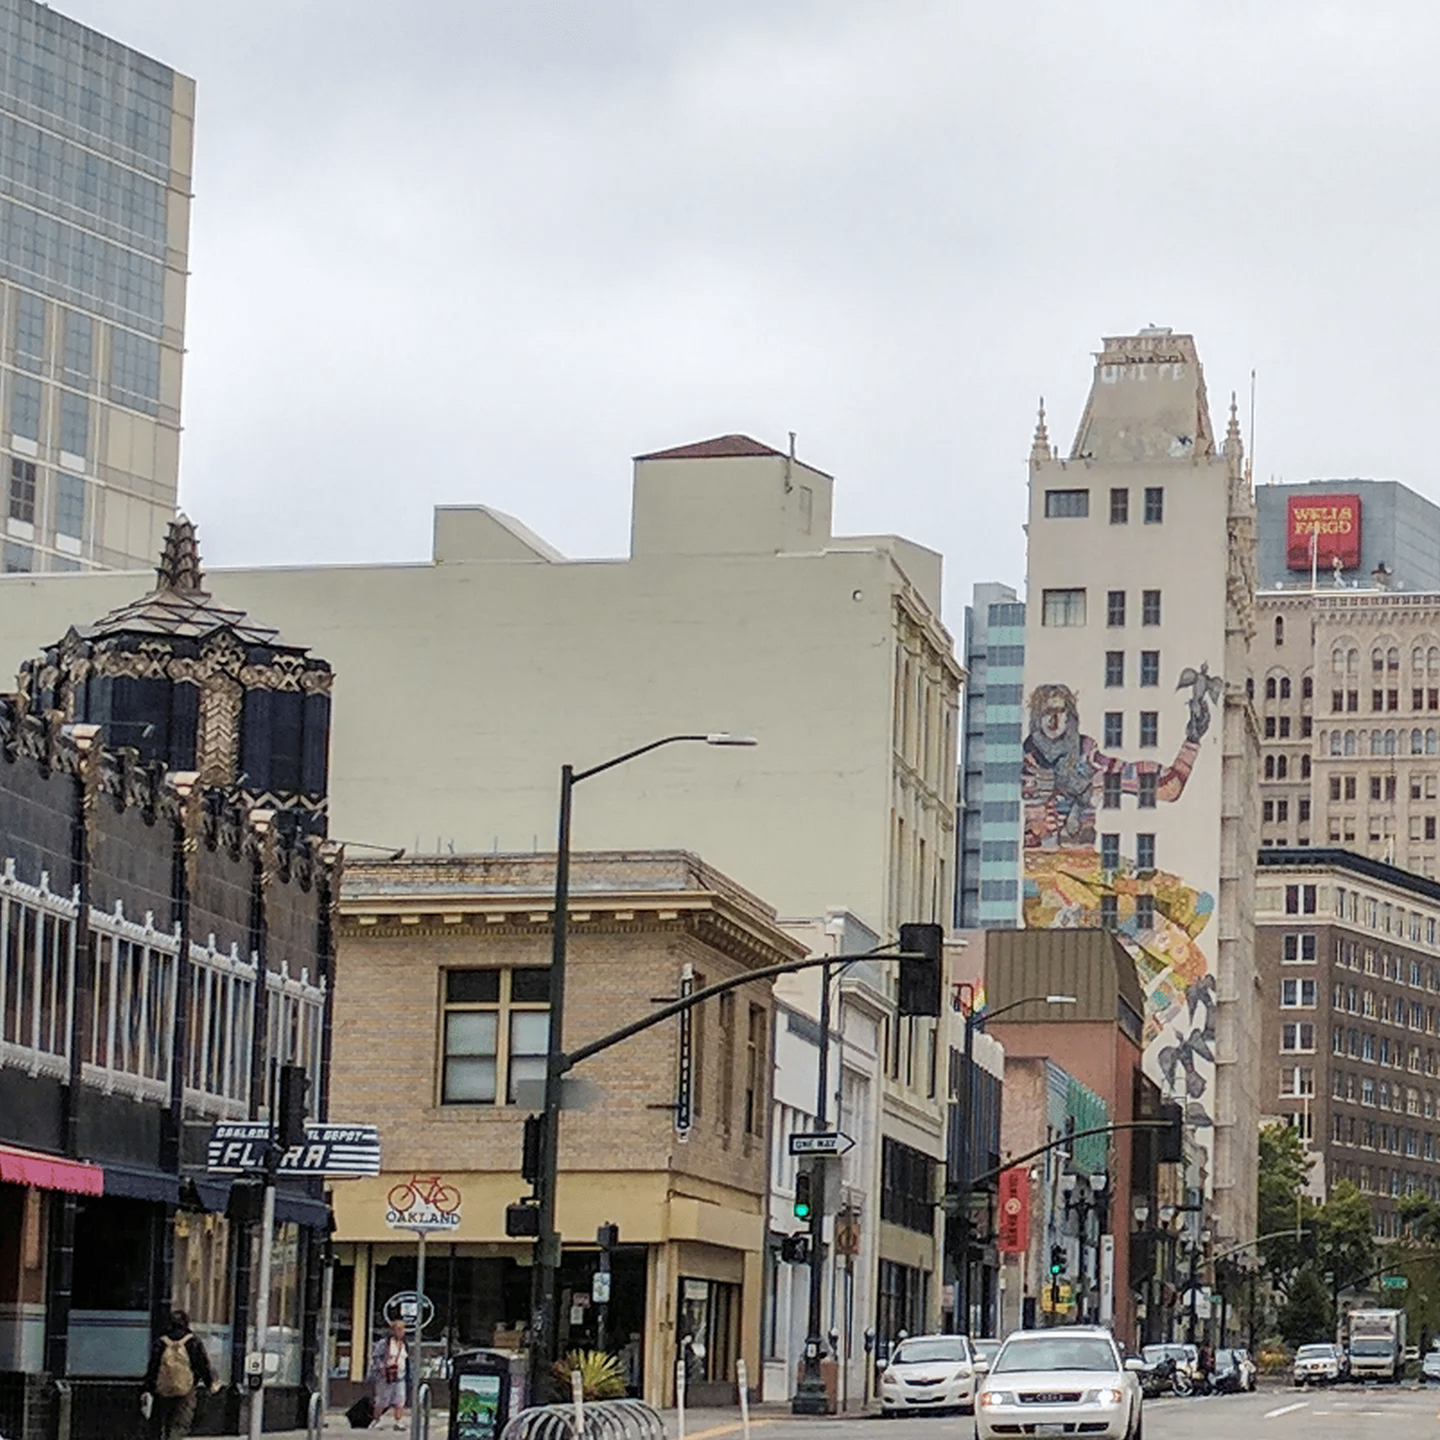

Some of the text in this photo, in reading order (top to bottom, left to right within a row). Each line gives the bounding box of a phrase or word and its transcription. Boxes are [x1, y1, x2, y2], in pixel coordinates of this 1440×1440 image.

[1293, 507, 1352, 520] WELLS
[1294, 520, 1352, 534] FARGO
[817, 1140, 836, 1148] WAY
[222, 1142, 328, 1168] FLRA
[386, 1211, 461, 1225] OAKLAND
